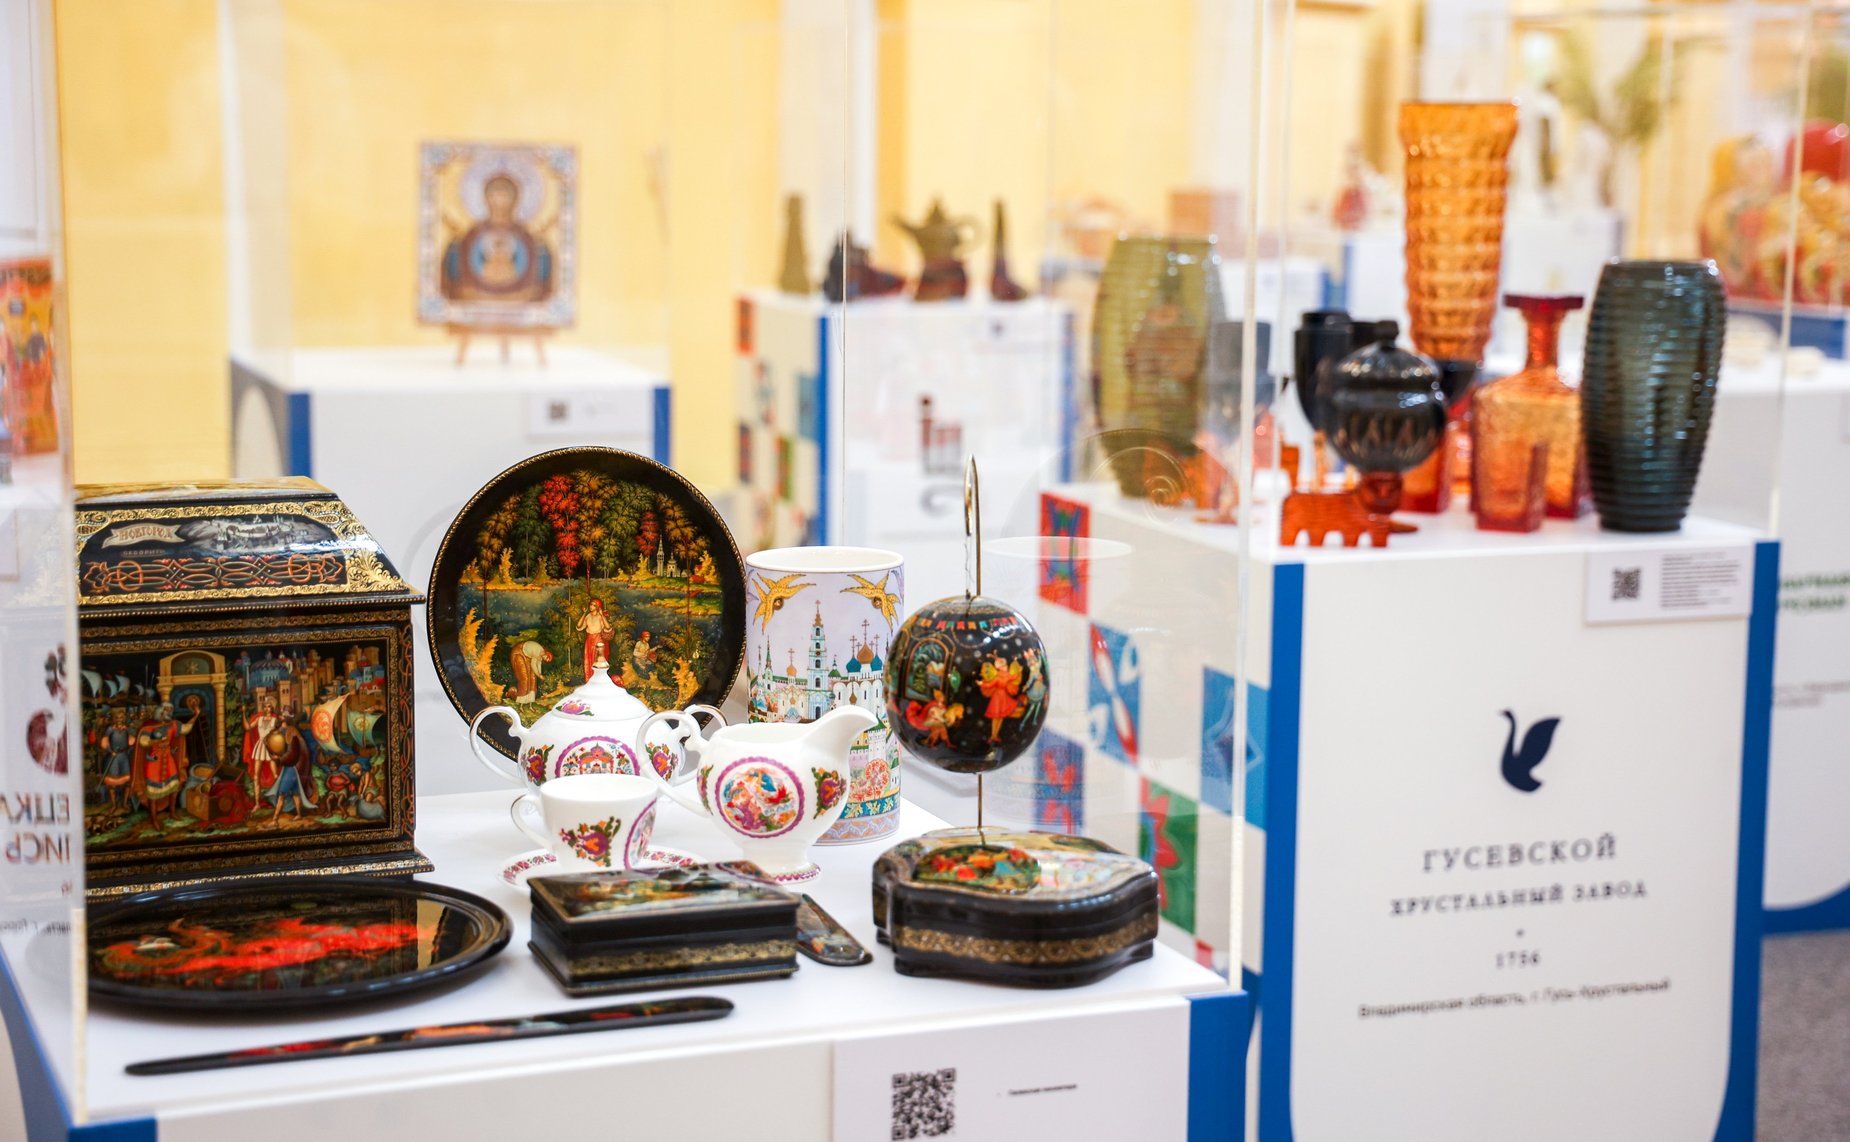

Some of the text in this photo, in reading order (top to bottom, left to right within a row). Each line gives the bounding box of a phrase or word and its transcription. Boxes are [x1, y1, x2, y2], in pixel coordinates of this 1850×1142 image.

[1422, 833, 1616, 872] ГУСЕВСКОЙ
[1391, 882, 1647, 916] ХРУСТАЛЬНЫЙ ЗАВОД
[1496, 952, 1540, 969] 1756
[1358, 997, 1463, 1018] Владимирская
